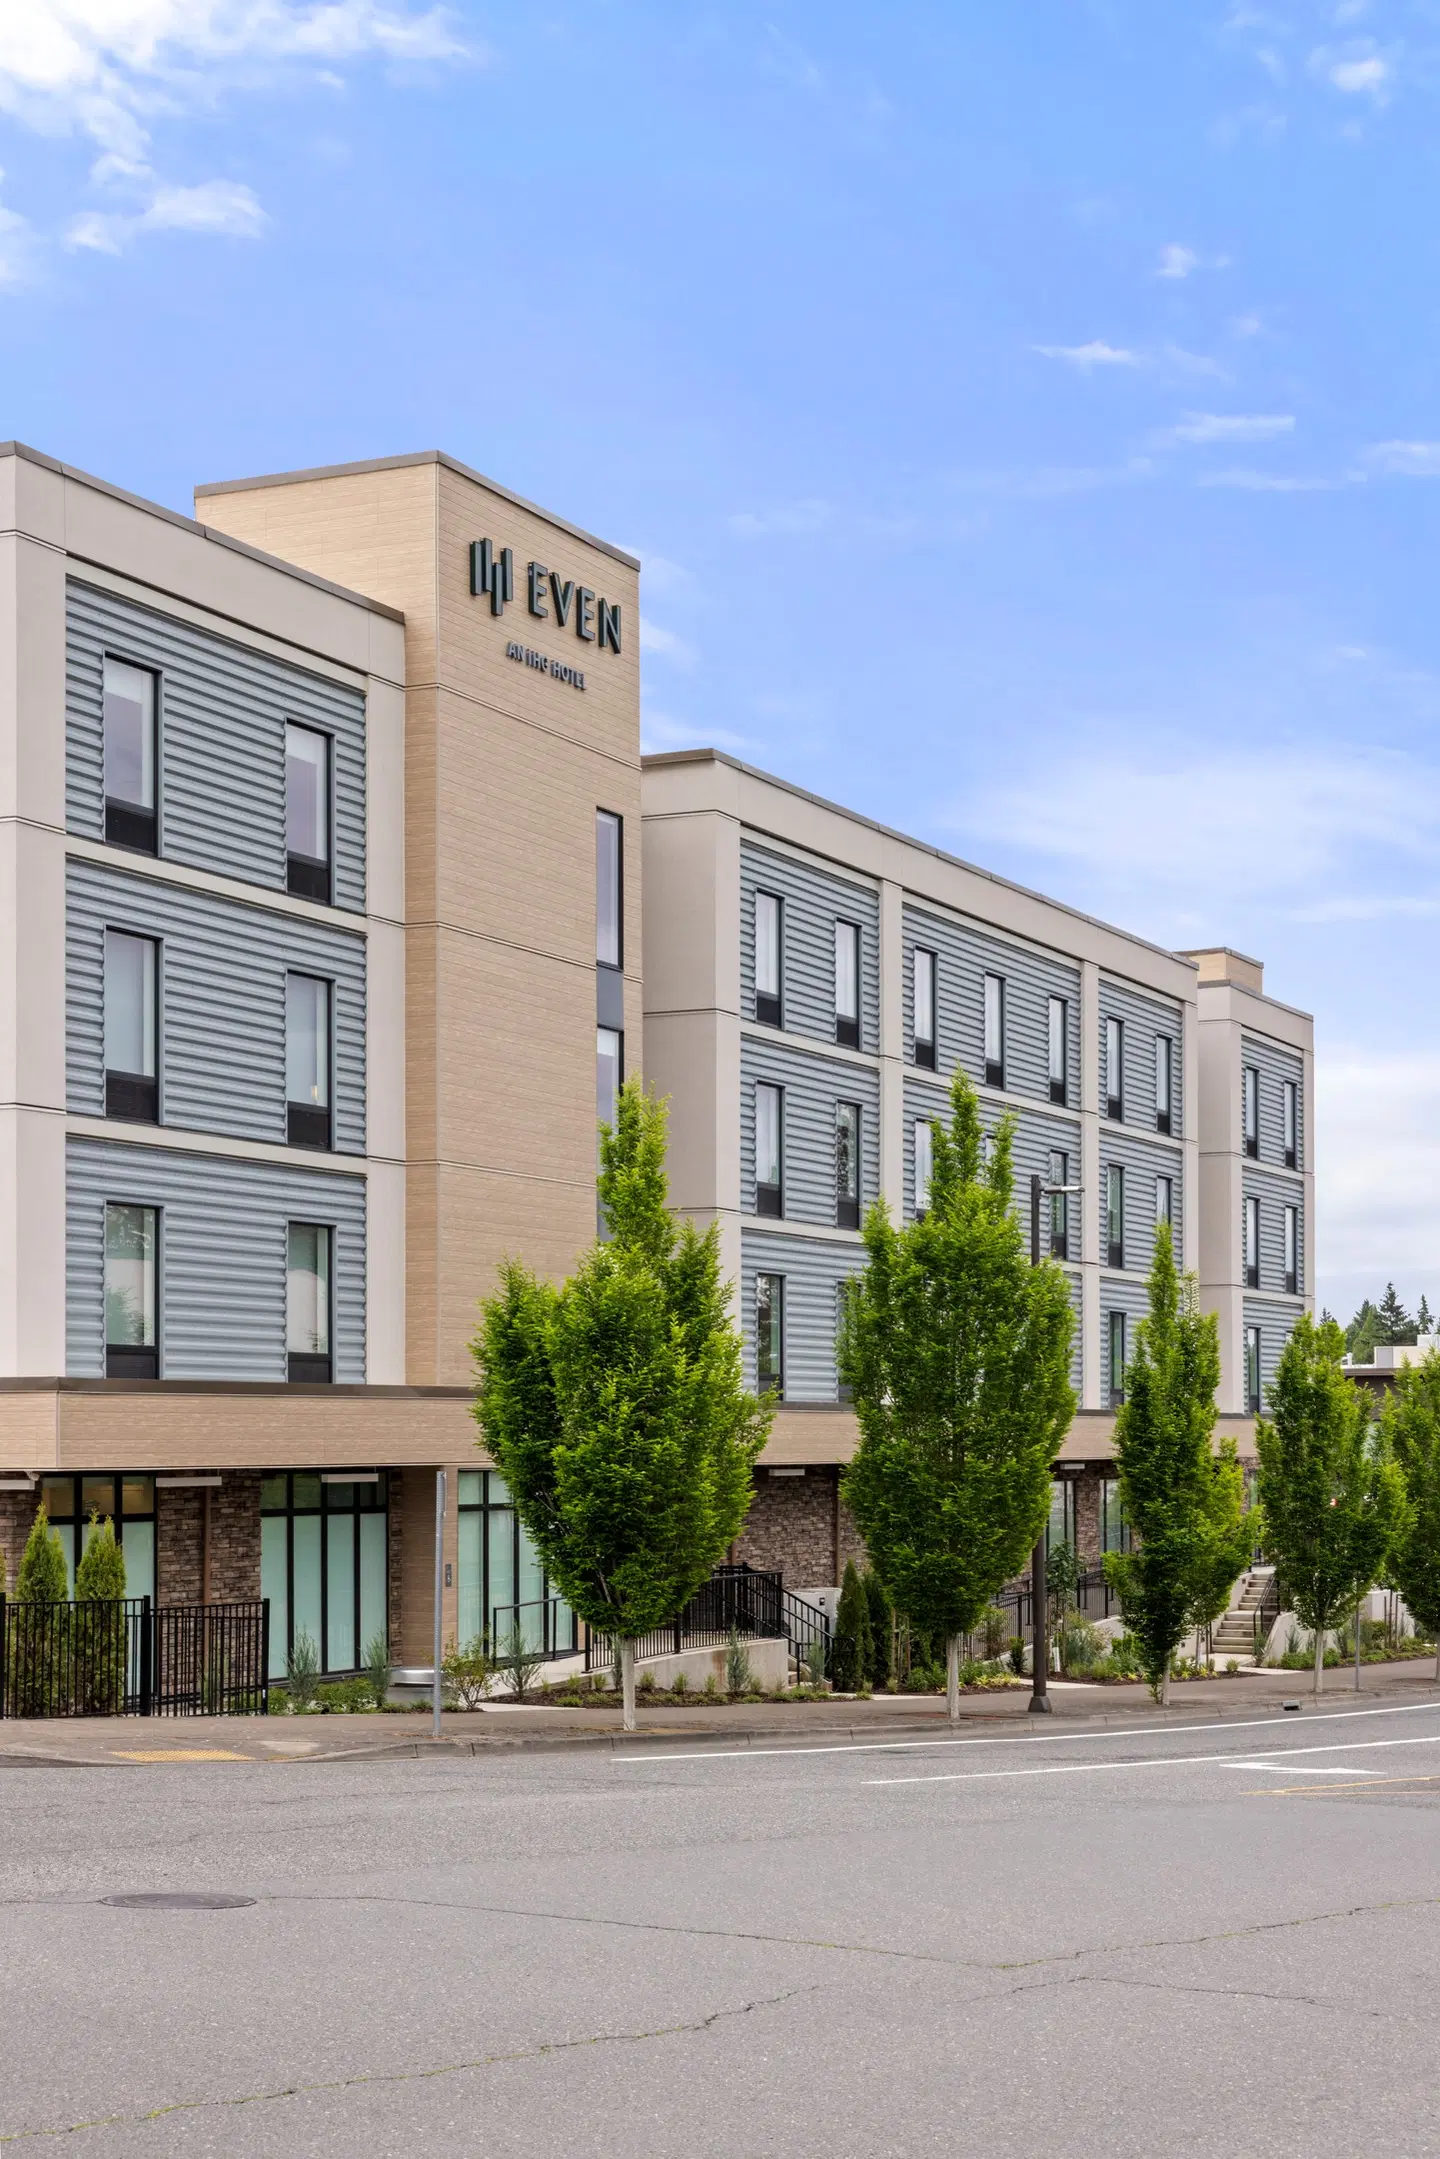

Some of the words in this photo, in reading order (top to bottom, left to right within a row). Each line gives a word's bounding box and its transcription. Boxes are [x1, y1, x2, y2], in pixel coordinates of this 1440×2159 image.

[528, 561, 622, 655] EVEN
[506, 641, 524, 662] AN
[525, 648, 549, 672] IHG
[550, 660, 586, 690] HOTEL
